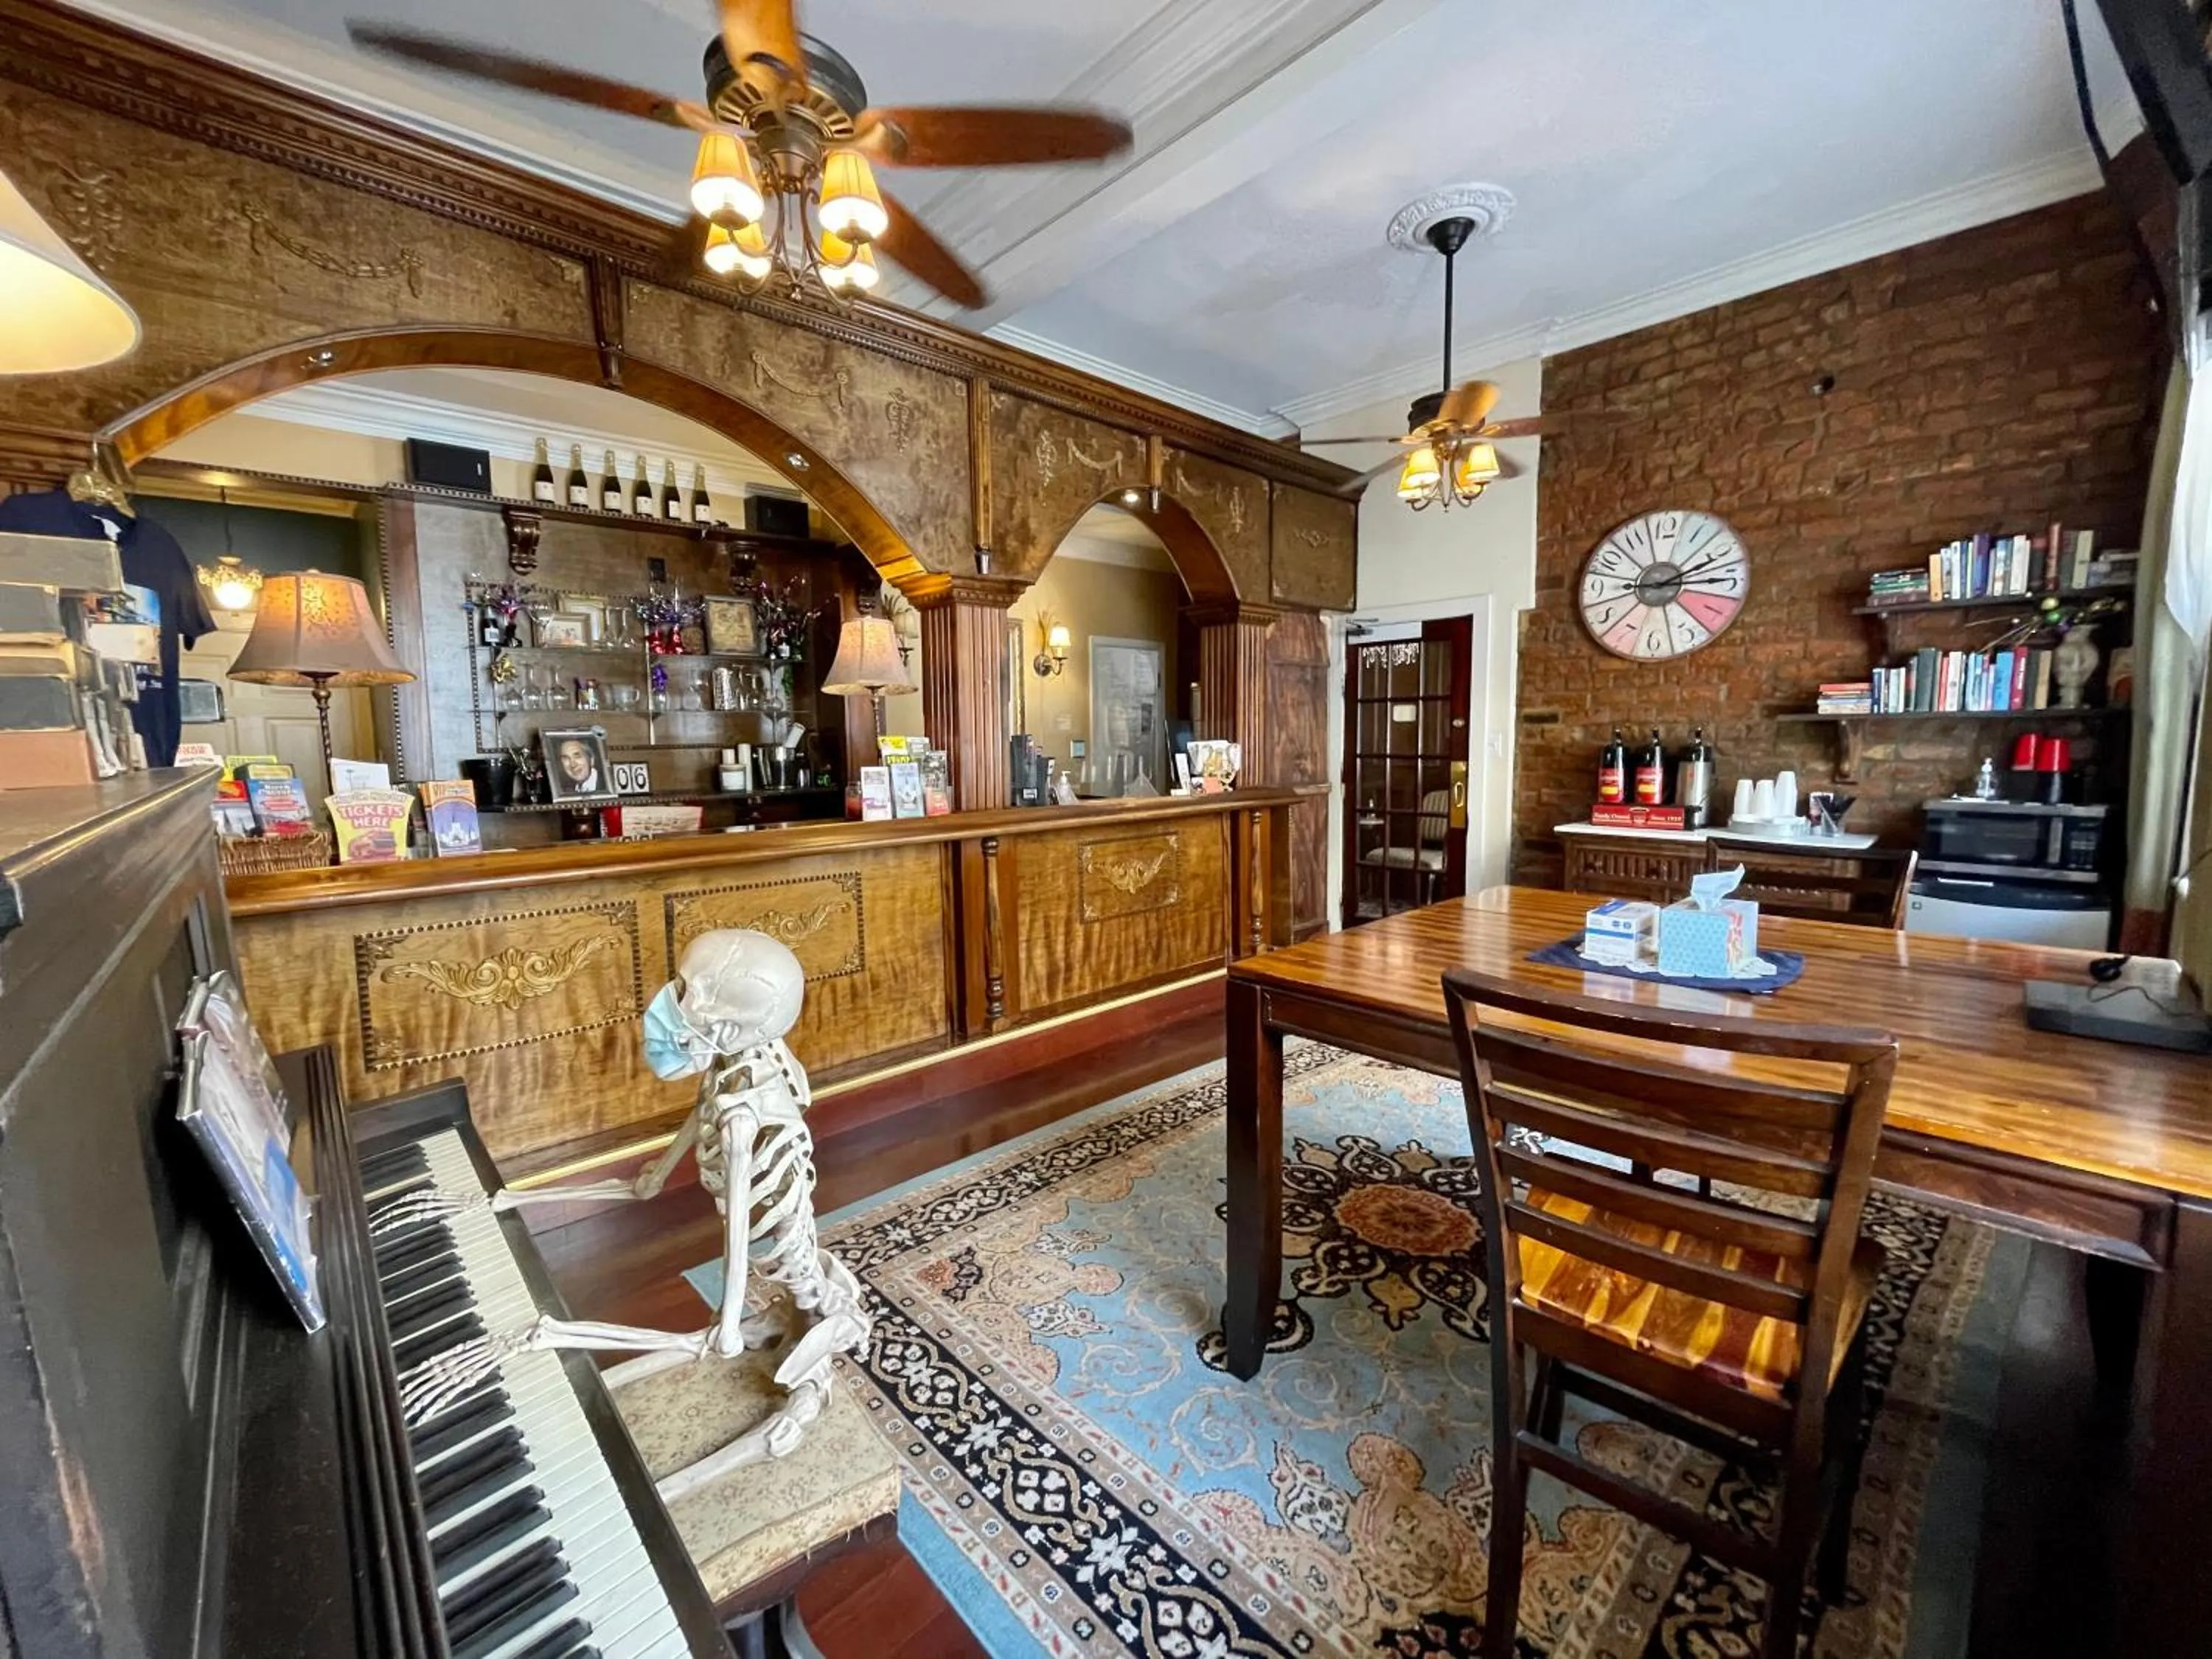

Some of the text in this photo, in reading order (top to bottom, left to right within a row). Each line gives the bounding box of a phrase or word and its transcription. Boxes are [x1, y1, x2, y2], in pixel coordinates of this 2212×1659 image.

[1655, 516, 1677, 540] 12
[1688, 524, 1705, 543] 1
[1625, 530, 1644, 550] 11
[1601, 550, 1622, 571] 10
[1706, 543, 1733, 562] 2
[1590, 578, 1604, 597] 9
[1596, 606, 1614, 625] 8
[1616, 622, 1638, 641] 7
[1646, 630, 1661, 651] 6
[1677, 622, 1696, 643] 5
[339, 804, 404, 818] TICKETS
[354, 815, 389, 827] HERE
